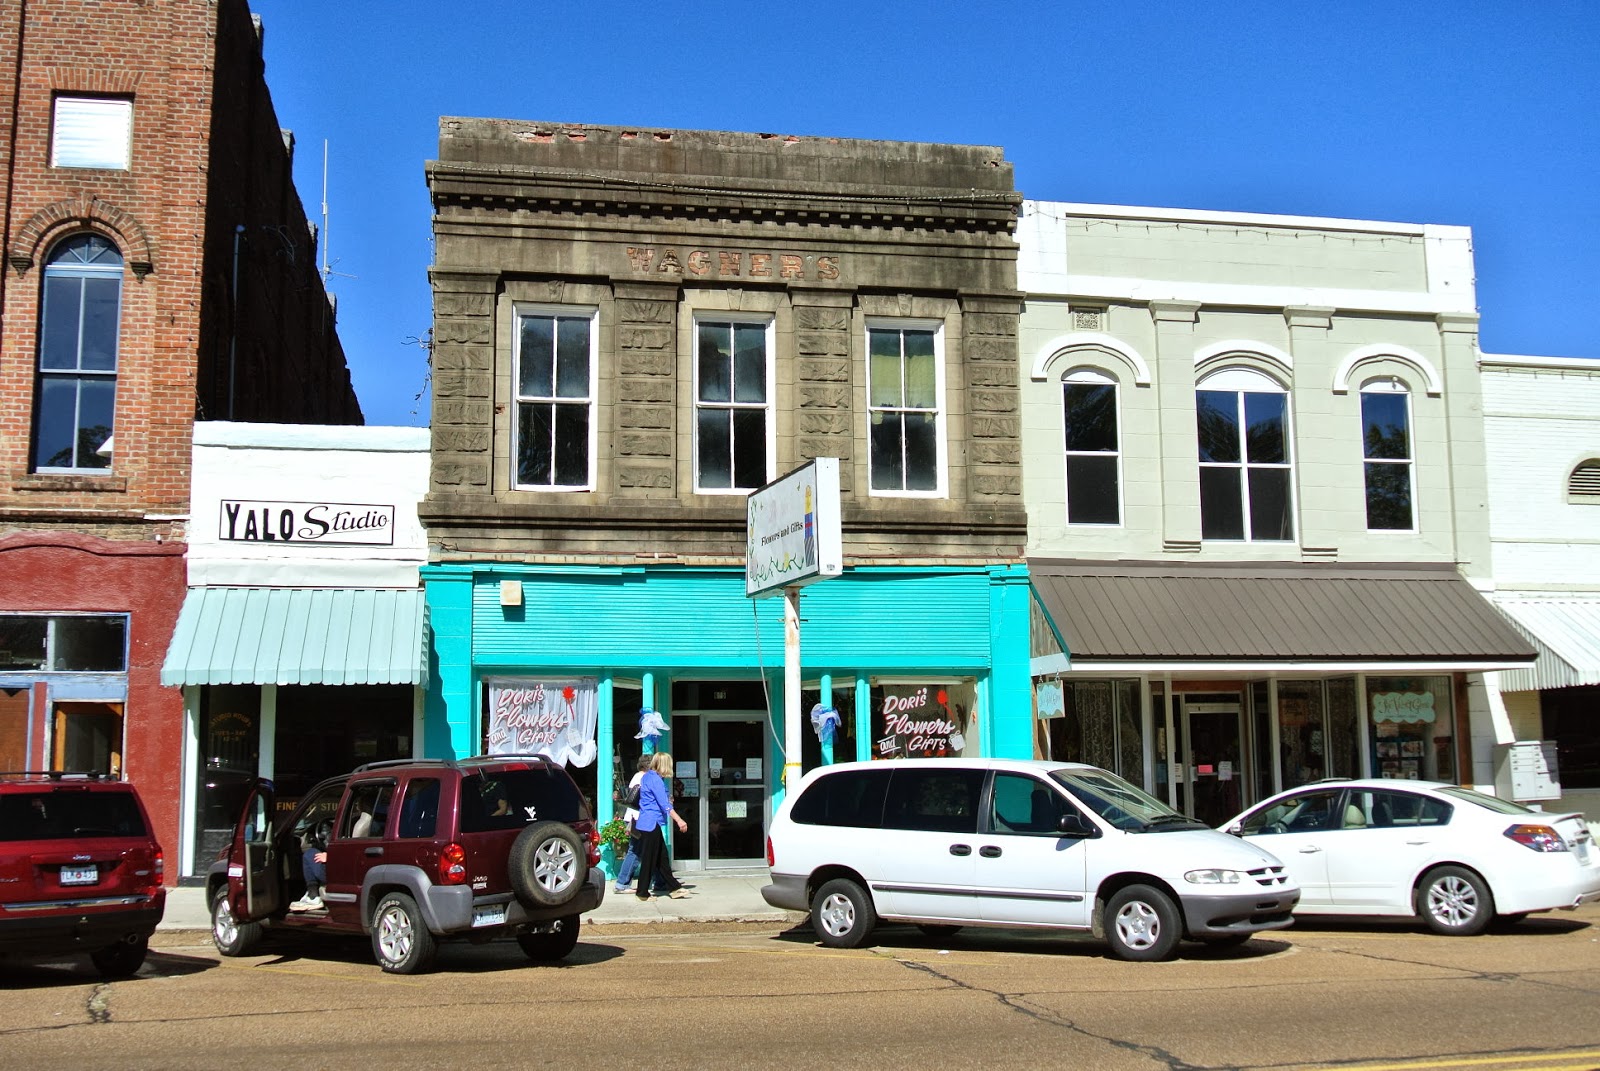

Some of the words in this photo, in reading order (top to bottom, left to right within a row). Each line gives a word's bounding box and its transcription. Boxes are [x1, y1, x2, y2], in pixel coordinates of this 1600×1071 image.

[626, 247, 840, 280] WAGNER'S
[225, 503, 294, 540] YALO
[297, 505, 390, 540] Studio
[761, 531, 780, 546] Flowers
[781, 526, 789, 538] and
[790, 521, 803, 534] Gifts
[495, 705, 569, 729] Flowers
[884, 713, 957, 736] Flowers
